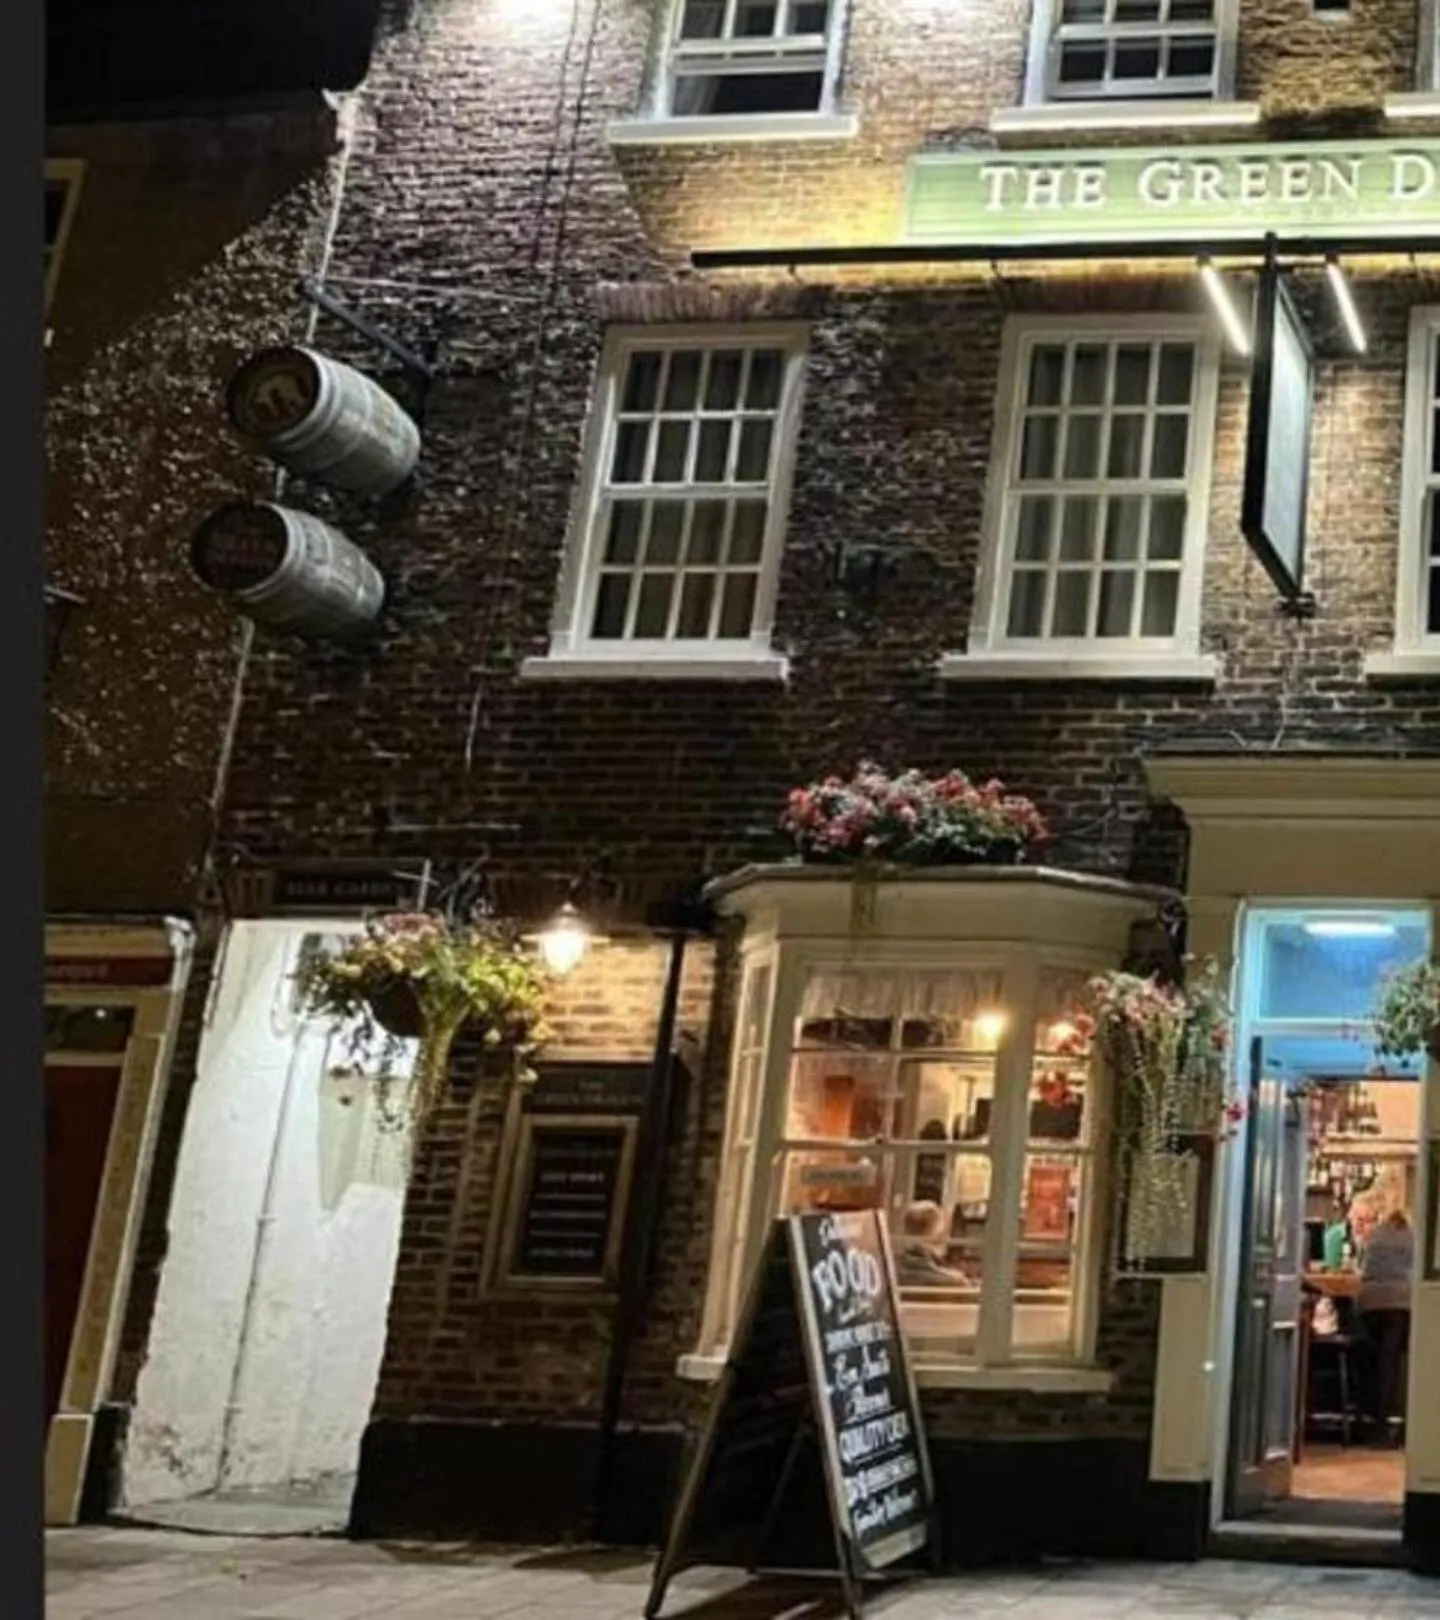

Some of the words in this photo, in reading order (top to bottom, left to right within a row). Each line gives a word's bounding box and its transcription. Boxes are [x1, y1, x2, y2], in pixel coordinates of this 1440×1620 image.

[978, 165, 1107, 212] THE
[1138, 156, 1364, 208] GREEN
[812, 1247, 882, 1310] FOOD
